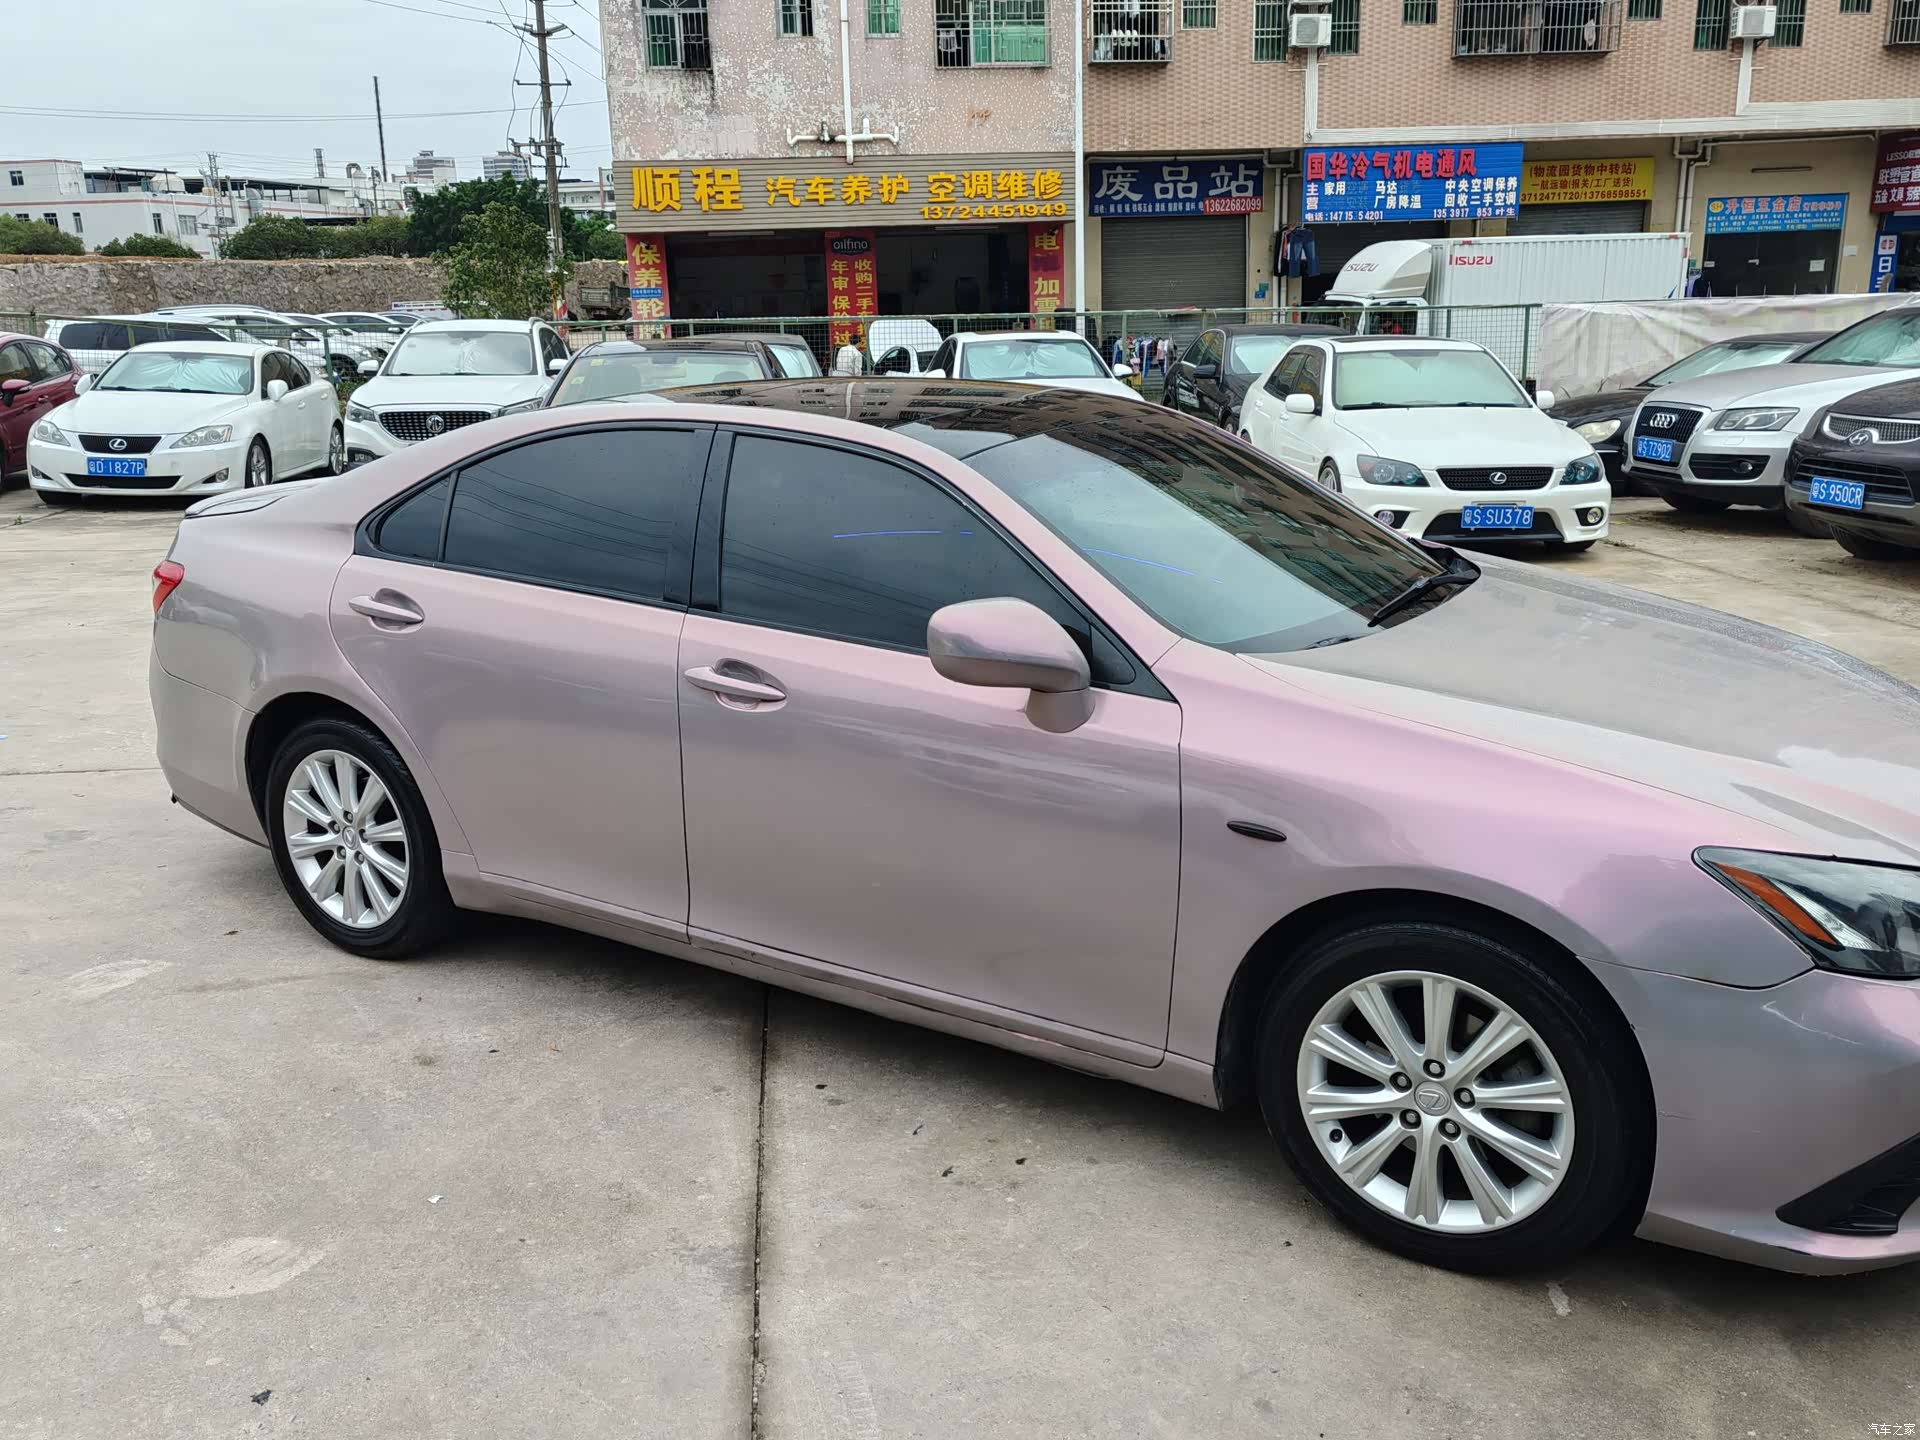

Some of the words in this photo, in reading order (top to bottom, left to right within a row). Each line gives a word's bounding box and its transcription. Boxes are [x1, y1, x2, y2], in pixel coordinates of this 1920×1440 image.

[1307, 149, 1477, 181] 国华冷气机电通风
[632, 166, 744, 212] 顺程
[766, 173, 910, 207] 汽车养护
[927, 169, 1064, 203] 空调维修
[1094, 164, 1260, 202] 废品站
[1324, 181, 1346, 196] 家用
[1375, 180, 1397, 195] 马达
[1445, 177, 1517, 192] 中央空调保养
[1205, 198, 1262, 212] 13622682099
[1374, 194, 1422, 209] 厂房降温
[1444, 191, 1516, 207] 回收二手空调
[920, 202, 1067, 219] 13724451949
[1344, 262, 1379, 272] ISUZU
[1455, 255, 1494, 266] ISUZU
